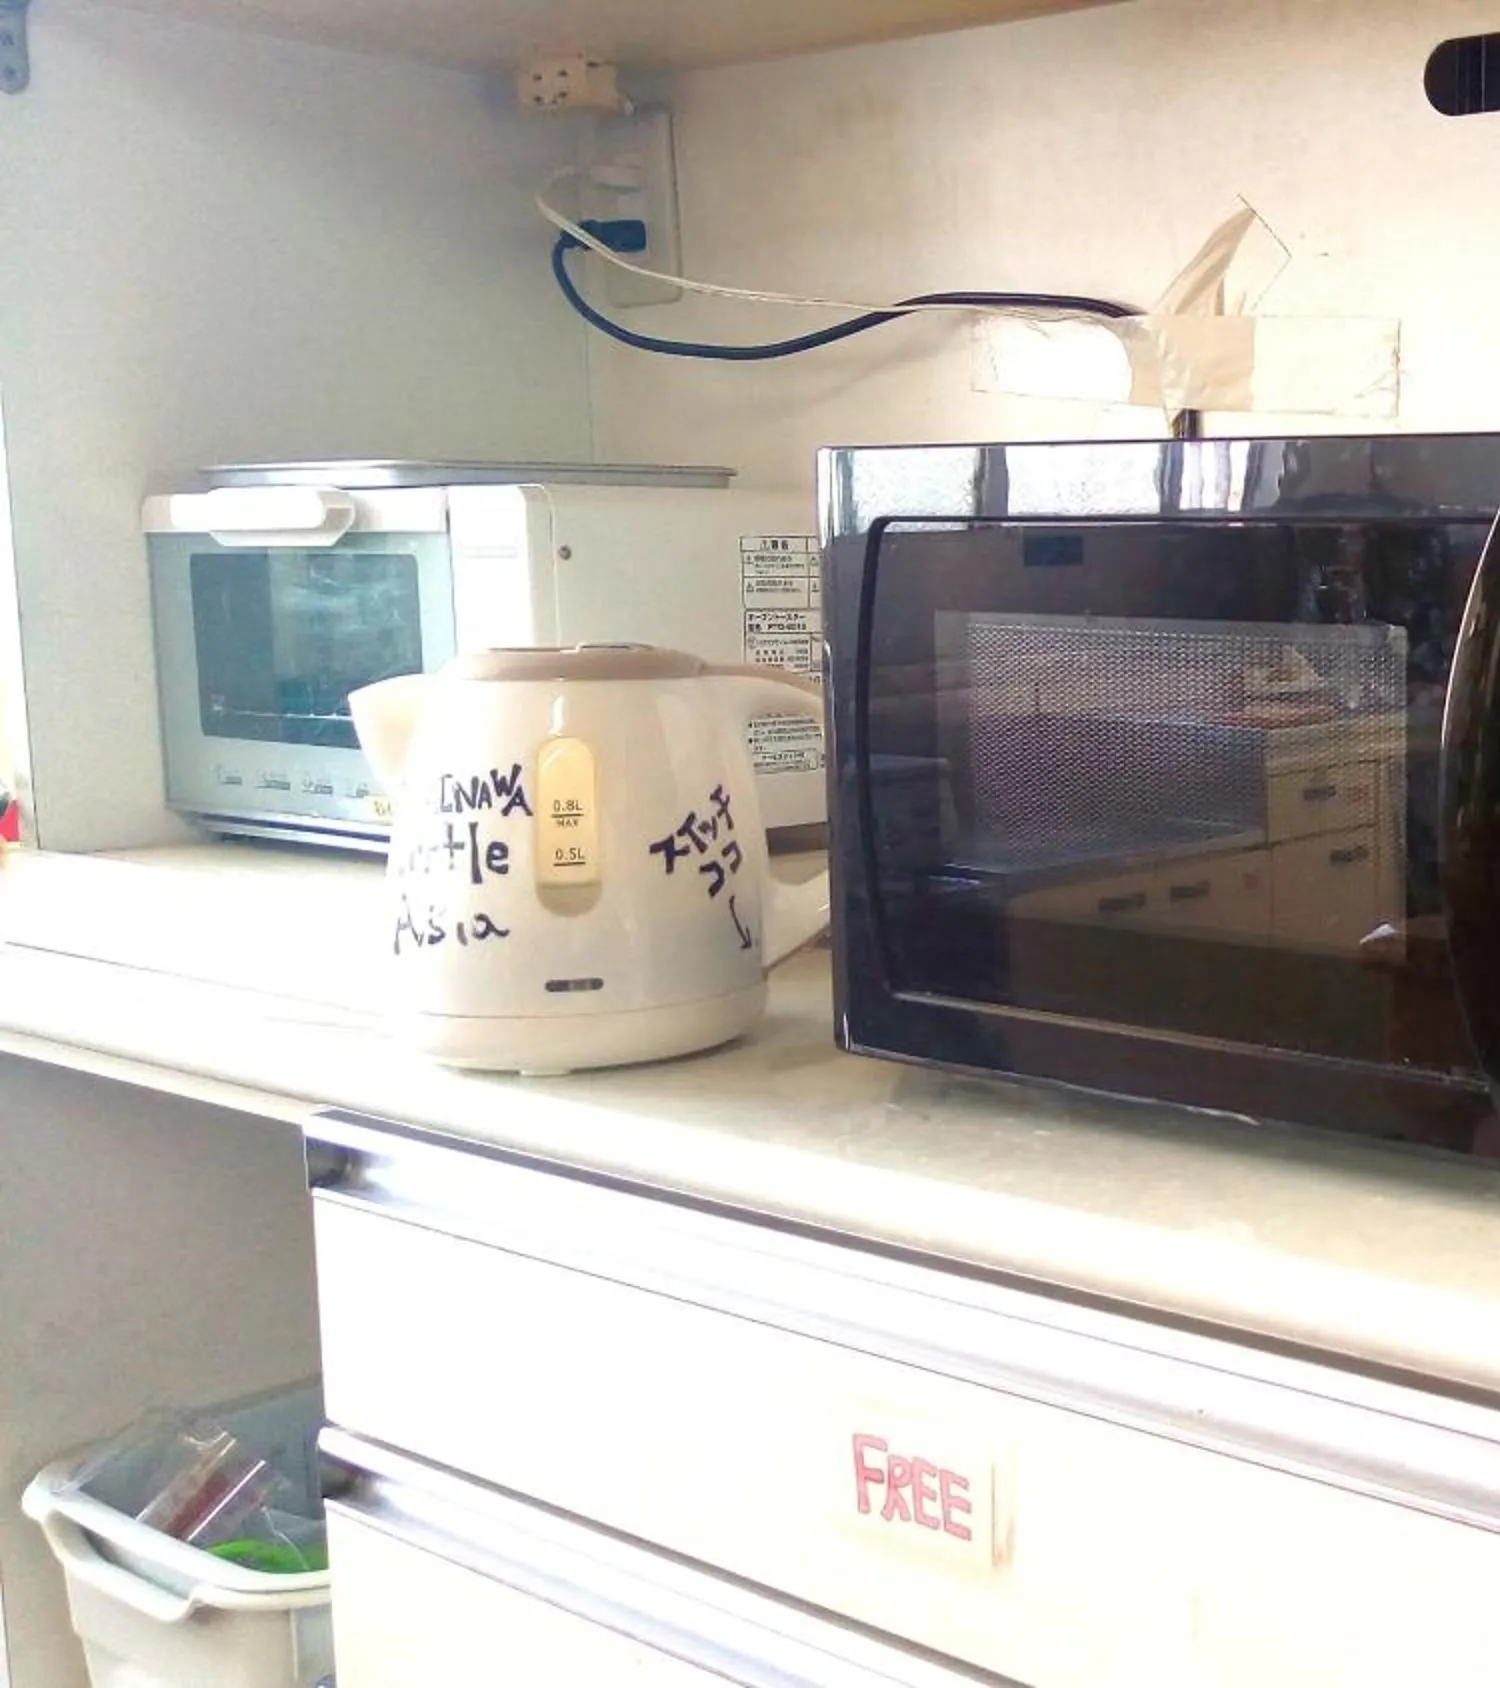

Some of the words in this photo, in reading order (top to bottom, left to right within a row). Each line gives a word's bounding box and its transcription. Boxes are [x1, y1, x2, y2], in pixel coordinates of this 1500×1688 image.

[553, 799, 583, 813] 0.8L
[649, 784, 734, 875] スイッチ
[555, 848, 586, 862] 0.5L
[852, 1432, 973, 1541] FREE
